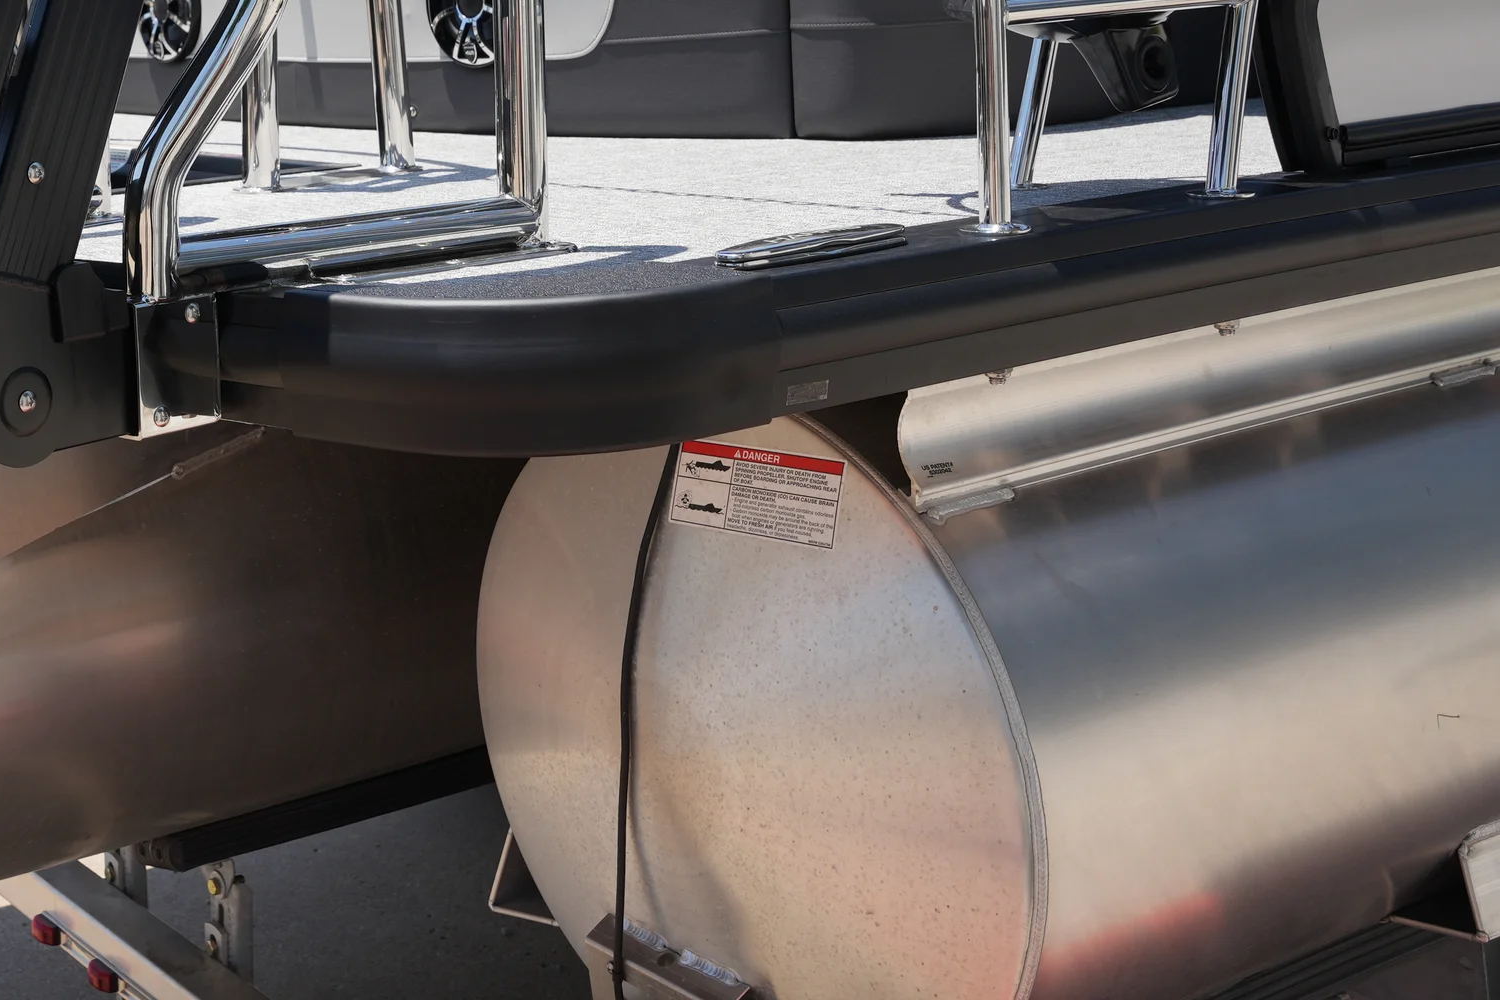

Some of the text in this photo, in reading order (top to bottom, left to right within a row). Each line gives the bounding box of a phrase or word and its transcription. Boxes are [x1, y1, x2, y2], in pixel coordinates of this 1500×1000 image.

[742, 451, 781, 464] DANGER
[930, 462, 953, 470] PATENT#
[787, 475, 808, 483] SHUTOFF
[786, 481, 822, 490] APPROACHING
[734, 497, 748, 505] Engine
[758, 502, 777, 510] generator
[753, 517, 769, 525] engines
[775, 521, 798, 530] generators
